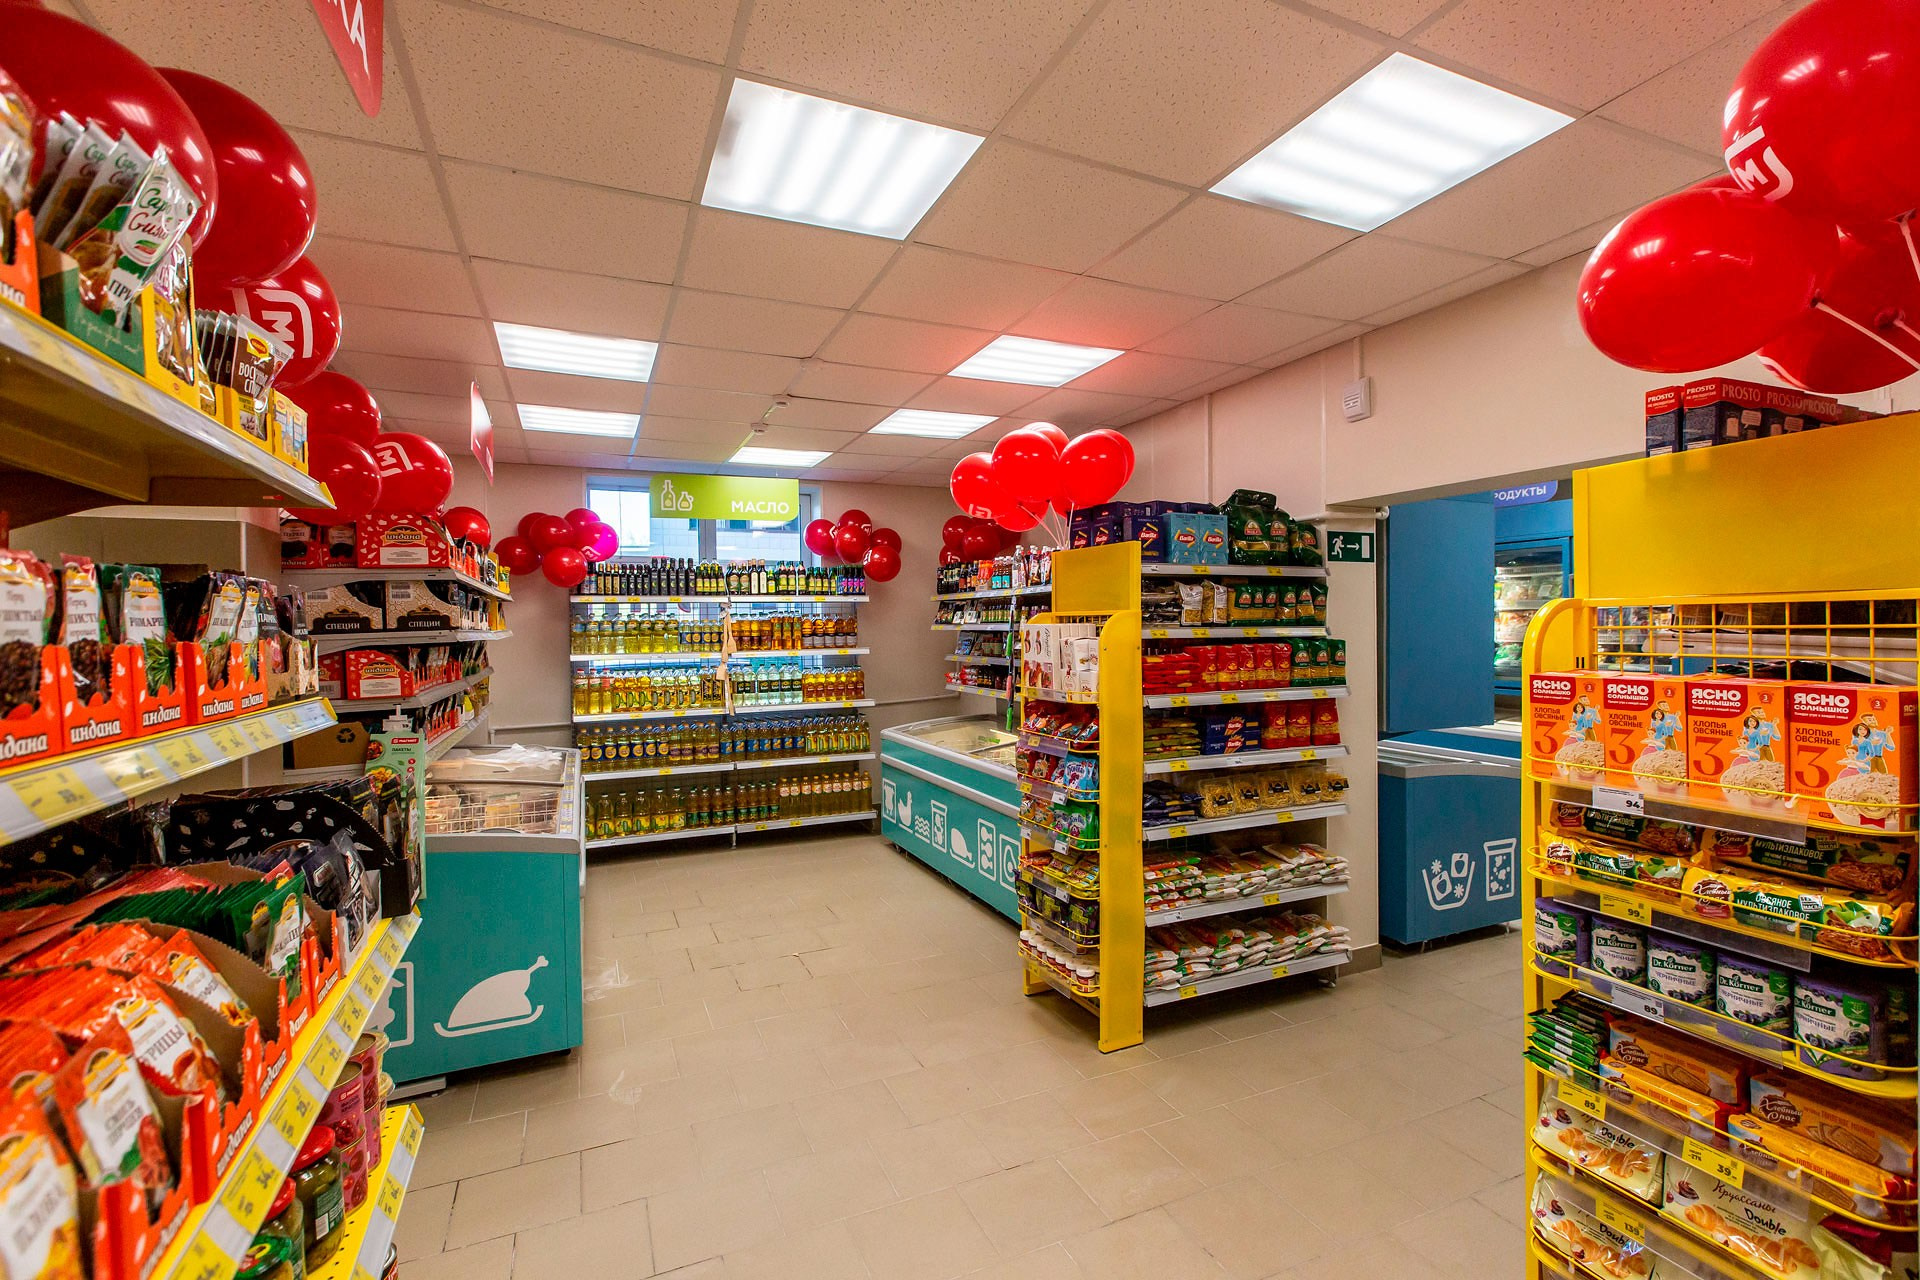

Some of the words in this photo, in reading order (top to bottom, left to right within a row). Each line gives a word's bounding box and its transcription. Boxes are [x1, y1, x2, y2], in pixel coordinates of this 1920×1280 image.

[1686, 384, 1716, 395] PROSTO
[1722, 384, 1761, 402] PROSTO
[1648, 392, 1675, 403] PROSTO
[1767, 391, 1803, 410] PROSTO
[1801, 398, 1837, 416] PROSTO
[731, 500, 790, 514] МАСЛО
[325, 622, 360, 630] СПЕЦИИ
[408, 620, 441, 628] СПЕЦИИ
[1533, 679, 1571, 690] ЯСНО
[1607, 683, 1649, 695] ЯСНО
[1691, 688, 1742, 701] ЯСНО
[1793, 692, 1850, 707] ЯСНО
[203, 699, 234, 717] индана
[1534, 706, 1560, 714] ХЛОПЬЯ
[1534, 713, 1565, 721] ОВСЯНЫЕ
[1608, 713, 1637, 721] ХЛОПЬЯ
[1608, 719, 1643, 728] ОВСЯНЫЕ
[70, 719, 121, 743] индана
[1693, 720, 1727, 729] ХЛОПЬЯ
[1534, 720, 1558, 755] 3
[1693, 727, 1734, 736] ОВСЯНЫЕ
[1795, 727, 1833, 737] ХЛОПЬЯ
[1609, 727, 1636, 765] 3
[1795, 735, 1841, 746] ОВСЯНЫЕ
[1693, 735, 1724, 776] 3
[1794, 745, 1830, 788] 3
[1754, 840, 1825, 860] МУЛЬТИЗЛАКОВОЕ
[1755, 893, 1793, 909] ОВСЯНОЕ
[1627, 908, 1640, 918] 99
[1644, 1004, 1658, 1015] 89
[1584, 1100, 1596, 1110] 89
[1761, 1097, 1803, 1117] Хлебный
[1600, 1127, 1636, 1149] Double
[1717, 1163, 1732, 1177] 39
[1712, 1180, 1777, 1213] Круассаны
[1744, 1206, 1787, 1236] Double
[1624, 1222, 1640, 1235] 139
